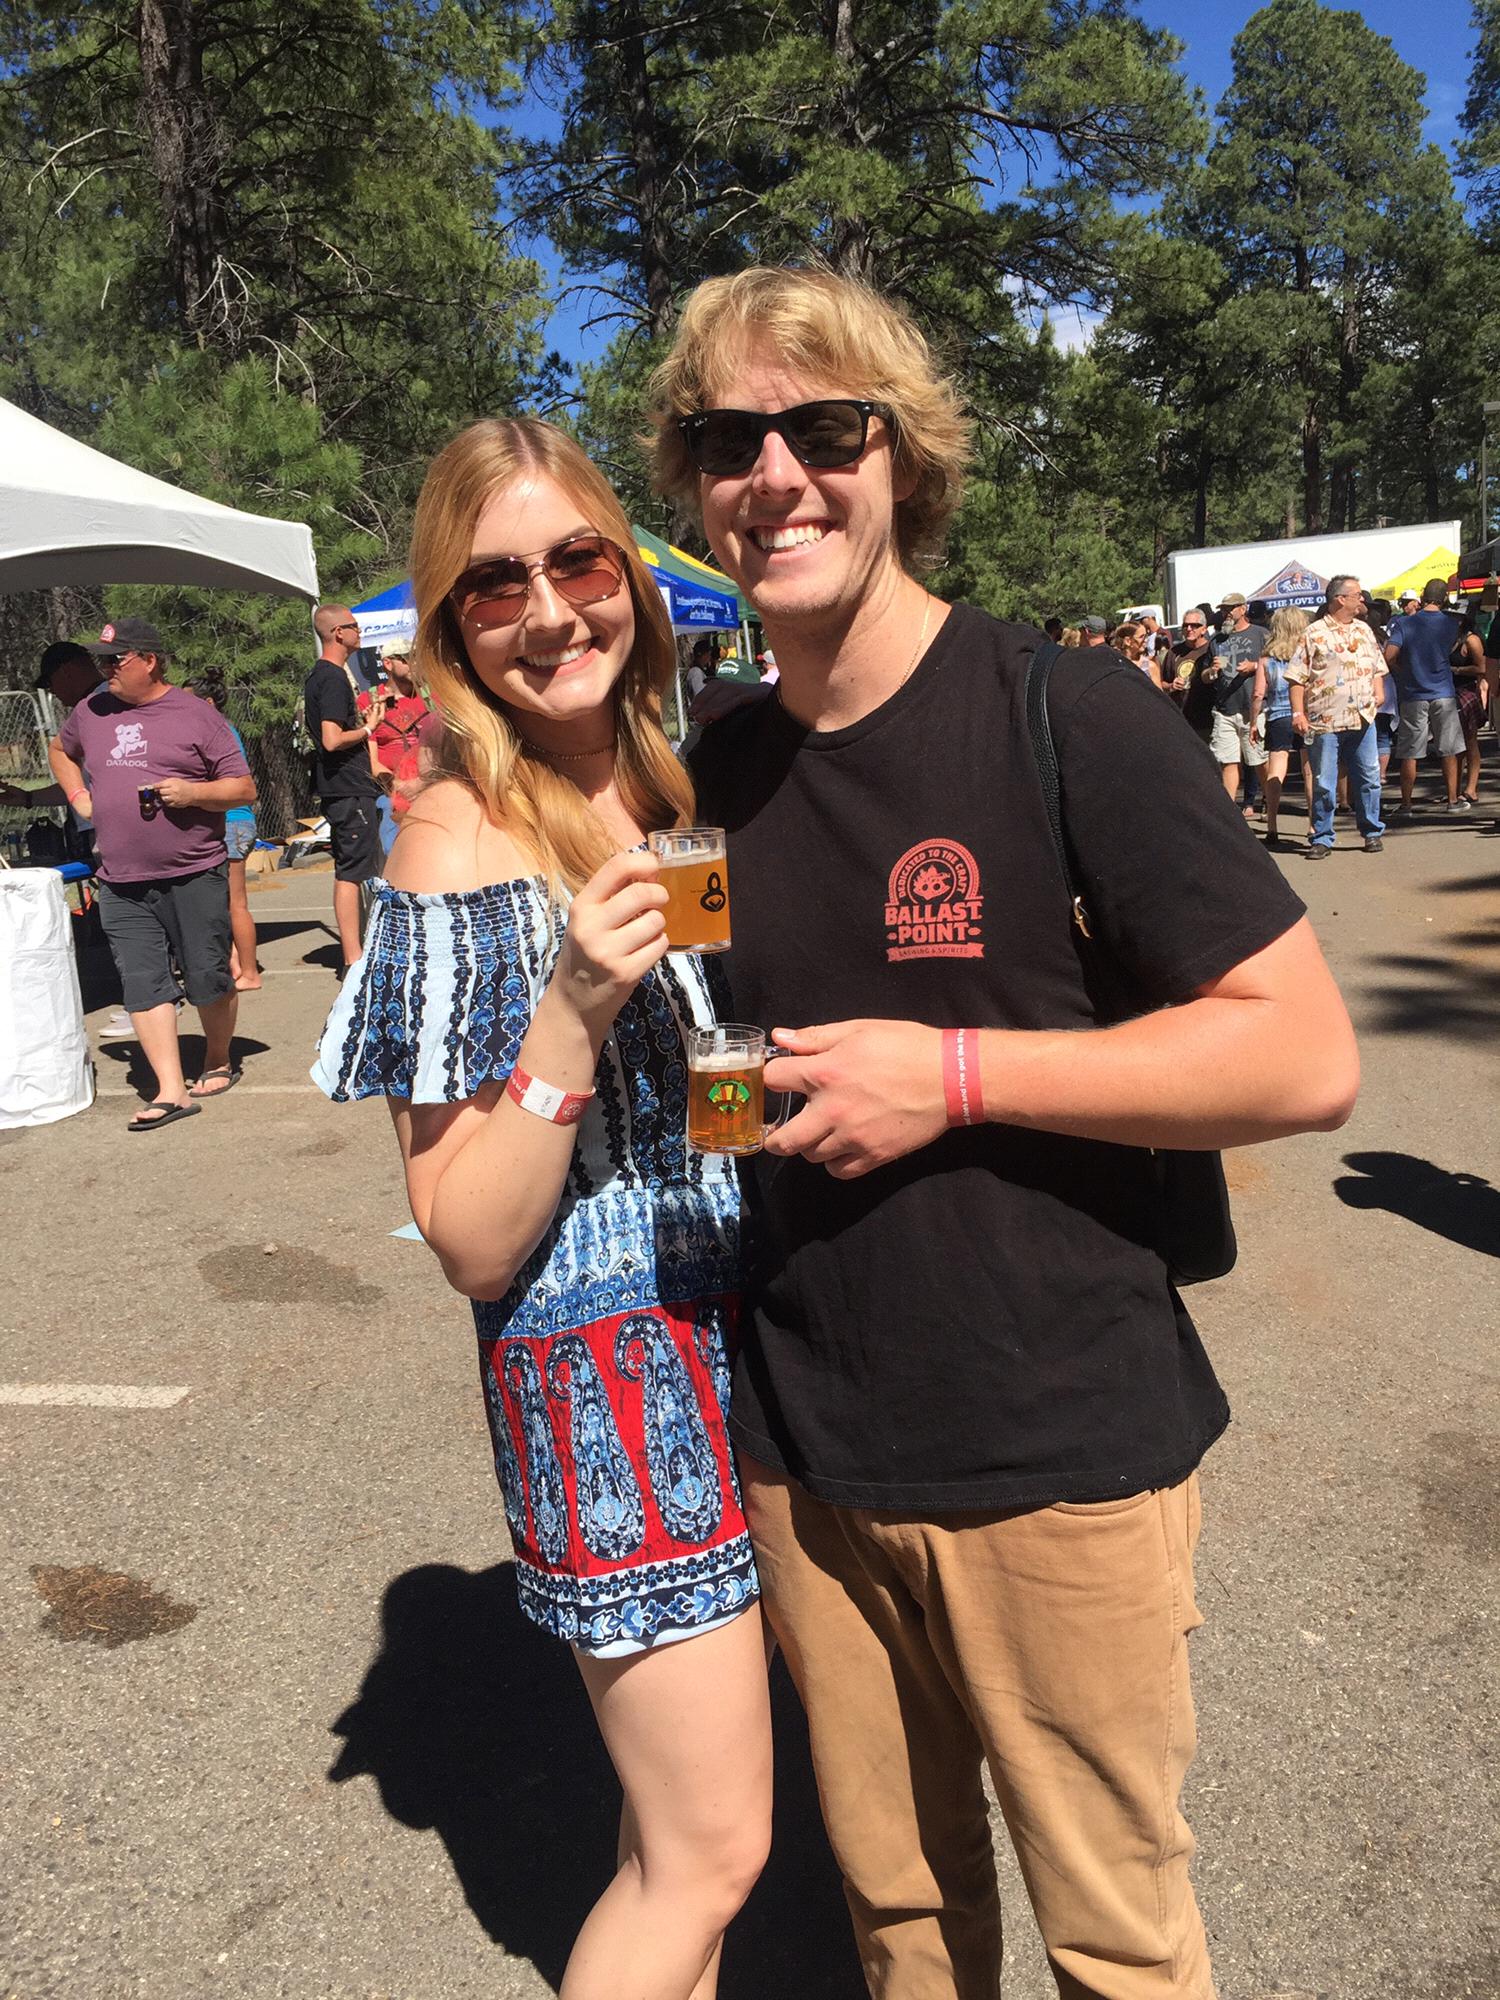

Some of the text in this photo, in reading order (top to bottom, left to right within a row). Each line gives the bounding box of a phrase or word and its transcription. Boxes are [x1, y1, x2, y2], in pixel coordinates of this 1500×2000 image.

[1266, 599, 1288, 609] THE
[1289, 597, 1315, 606] LOVE
[106, 759, 148, 768] DATADOG
[898, 849, 968, 898] DEDICATED TO THE CRAFT
[884, 900, 982, 926] BALLAST
[898, 921, 970, 944] POINT
[938, 946, 969, 955] SPIRITS
